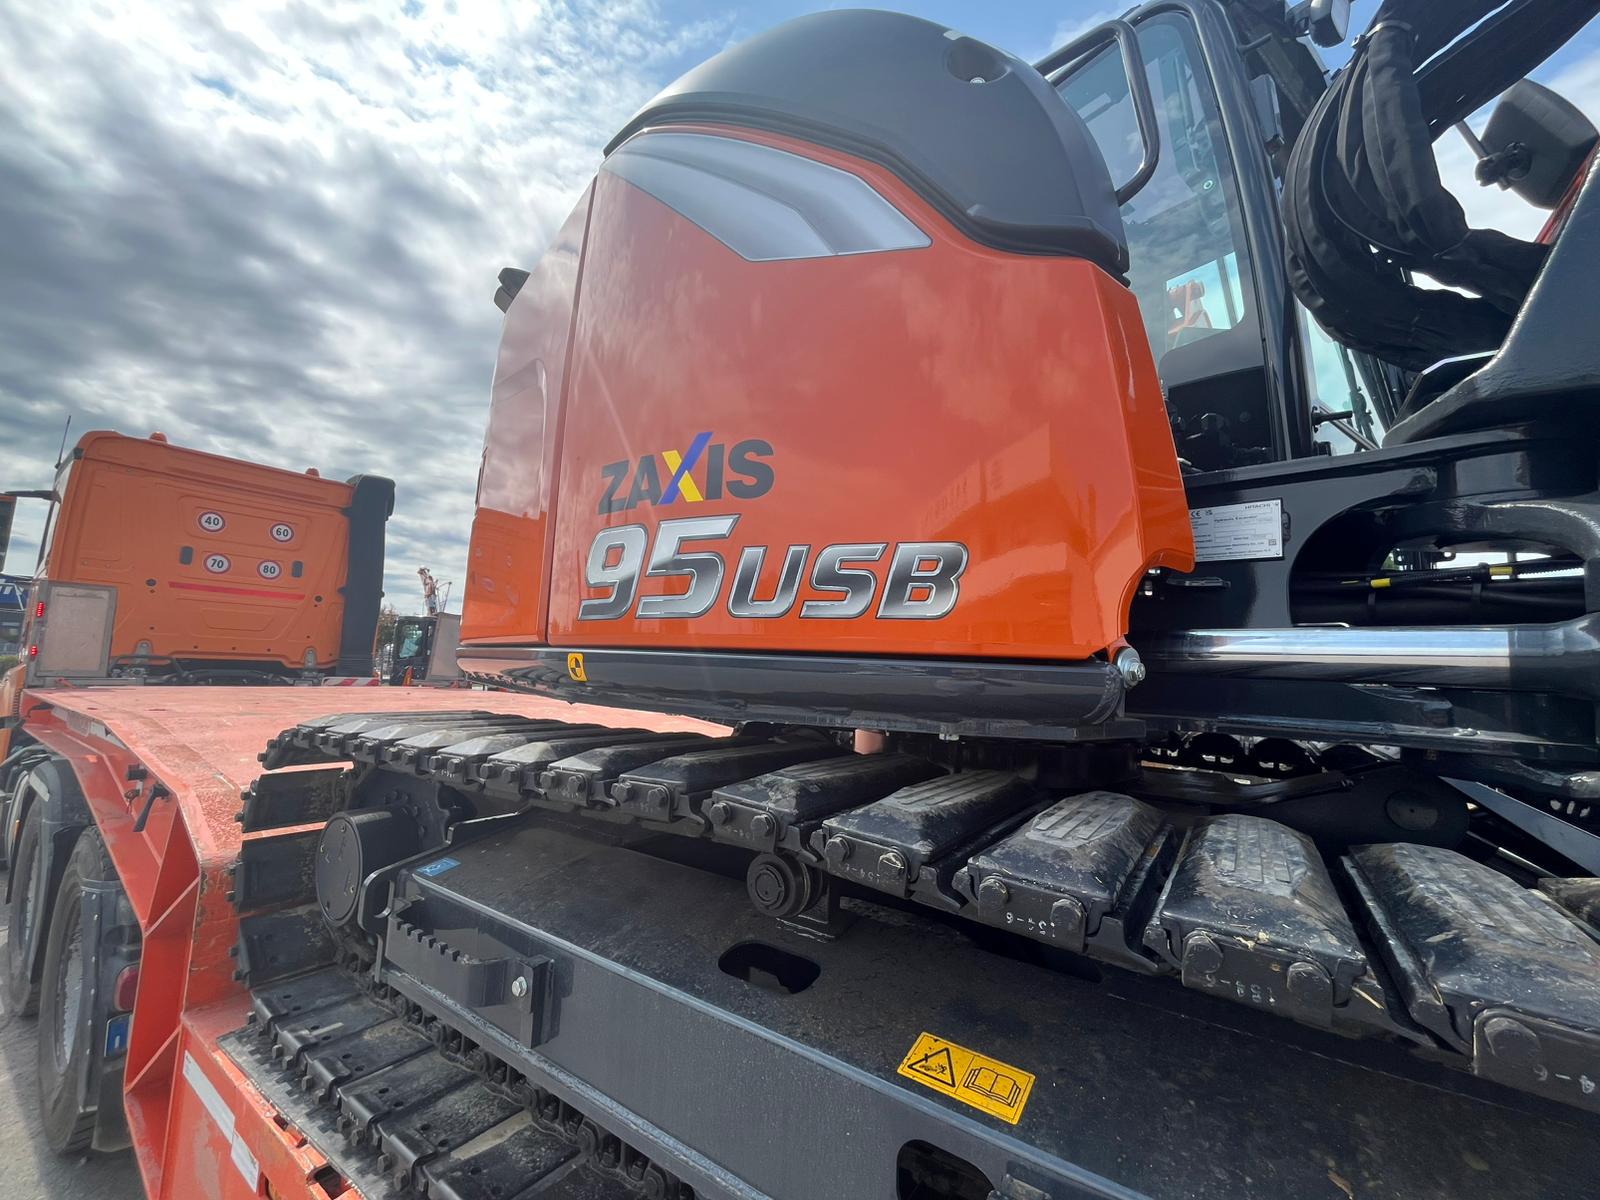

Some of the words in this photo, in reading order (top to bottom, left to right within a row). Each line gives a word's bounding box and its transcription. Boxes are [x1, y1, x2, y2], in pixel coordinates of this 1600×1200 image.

[598, 431, 775, 515] ZAXIS
[204, 516, 220, 527] 40
[275, 527, 289, 537] 60
[210, 558, 224, 569] 70
[262, 565, 276, 575] 80
